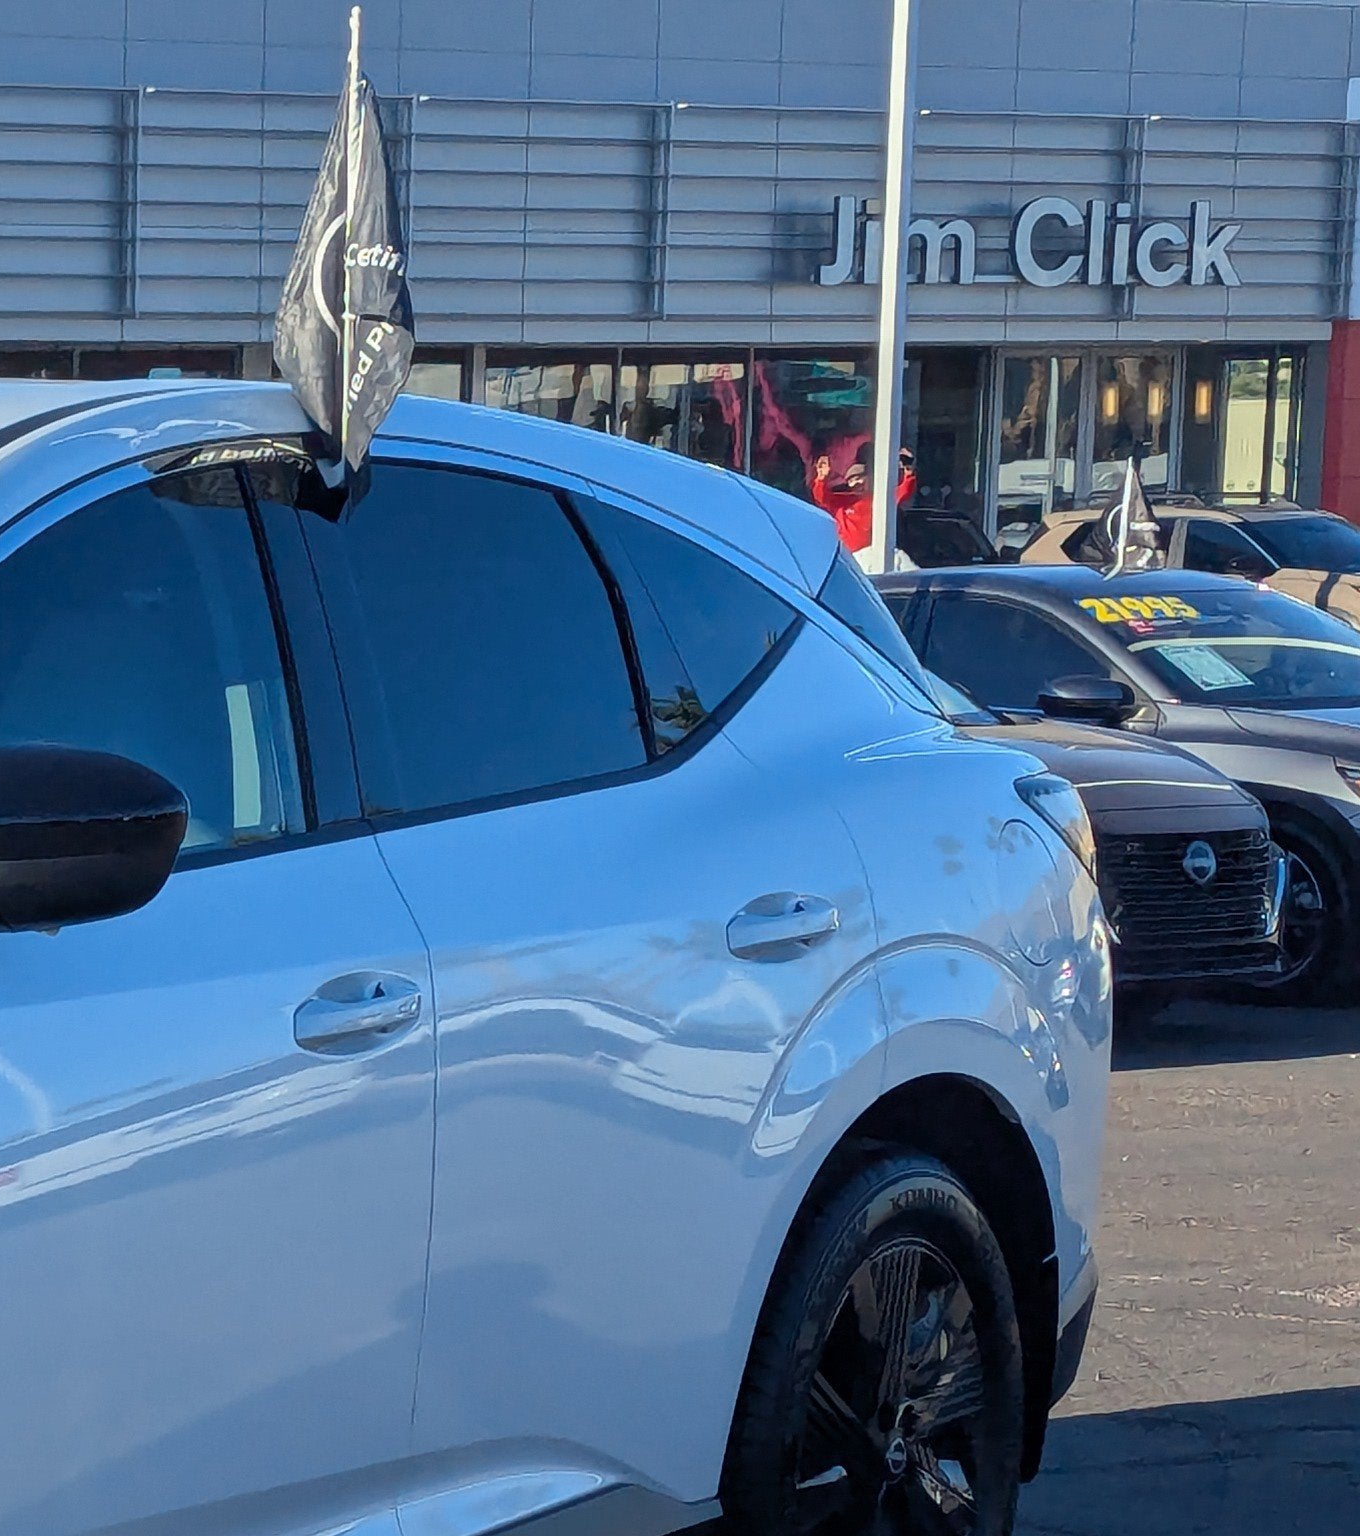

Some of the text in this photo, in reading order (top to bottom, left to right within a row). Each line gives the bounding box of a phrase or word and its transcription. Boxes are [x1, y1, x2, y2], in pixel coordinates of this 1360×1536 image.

[818, 195, 1242, 287] Jim Click
[1079, 596, 1200, 623] 21995
